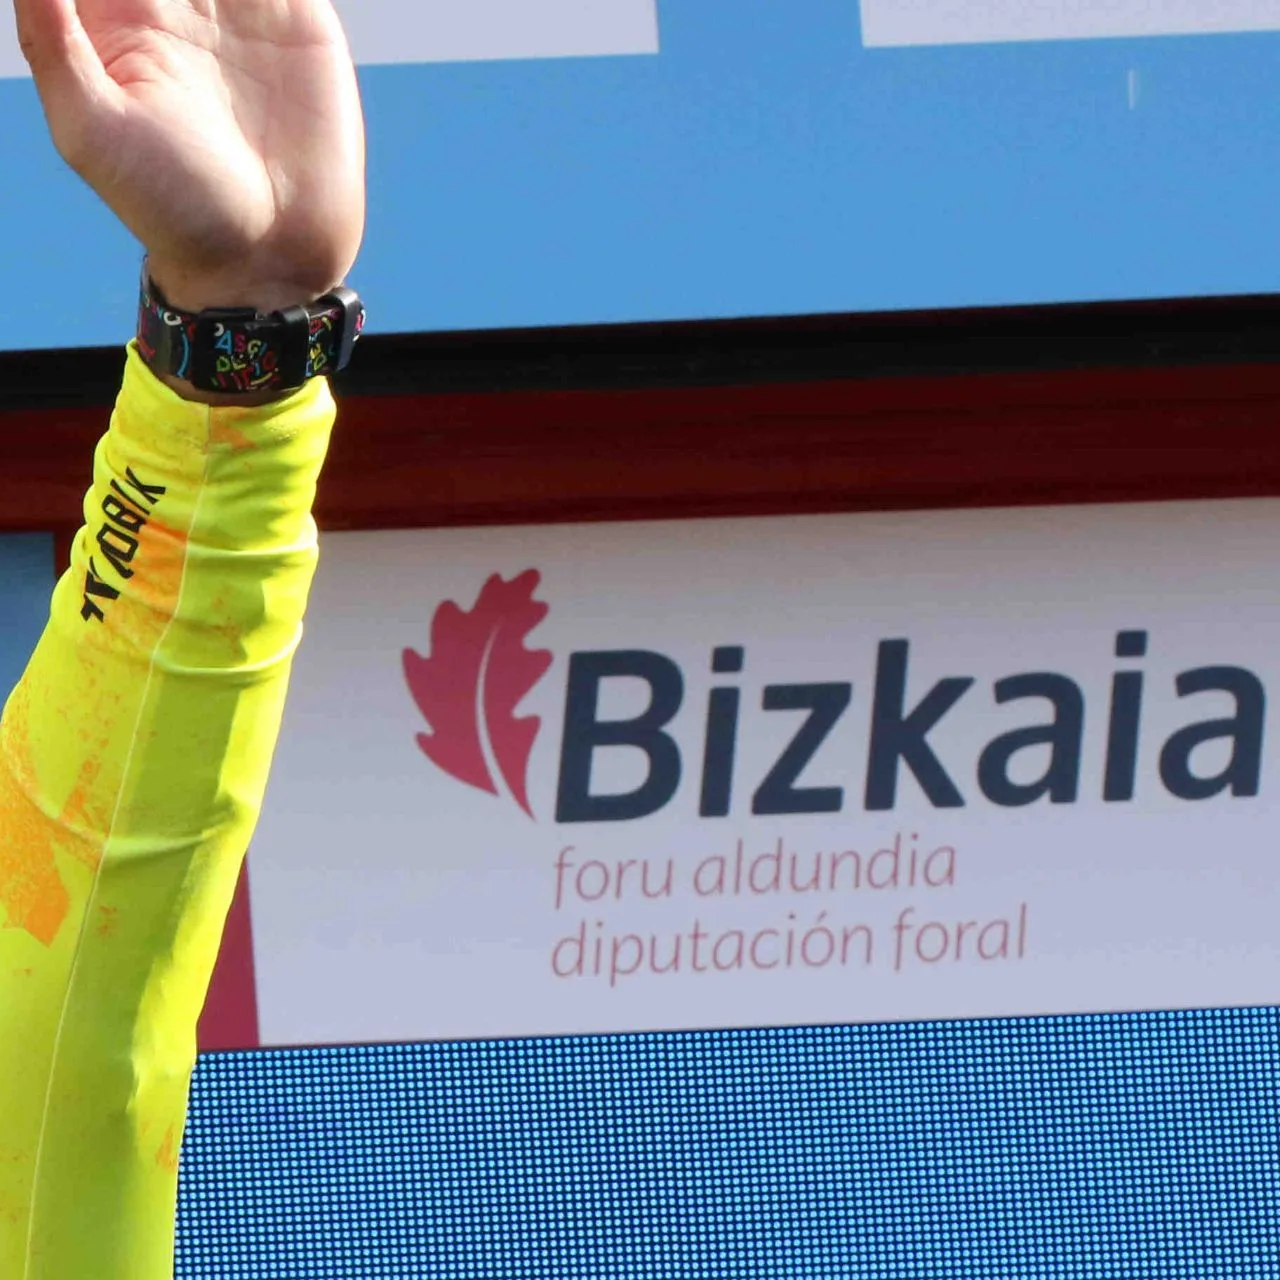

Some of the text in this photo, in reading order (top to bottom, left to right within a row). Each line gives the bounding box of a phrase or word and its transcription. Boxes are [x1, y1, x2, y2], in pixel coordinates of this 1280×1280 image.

[553, 630, 1268, 825] Bizkaia
[552, 832, 958, 911] foru aldundia
[550, 904, 1030, 988] diputación foral
